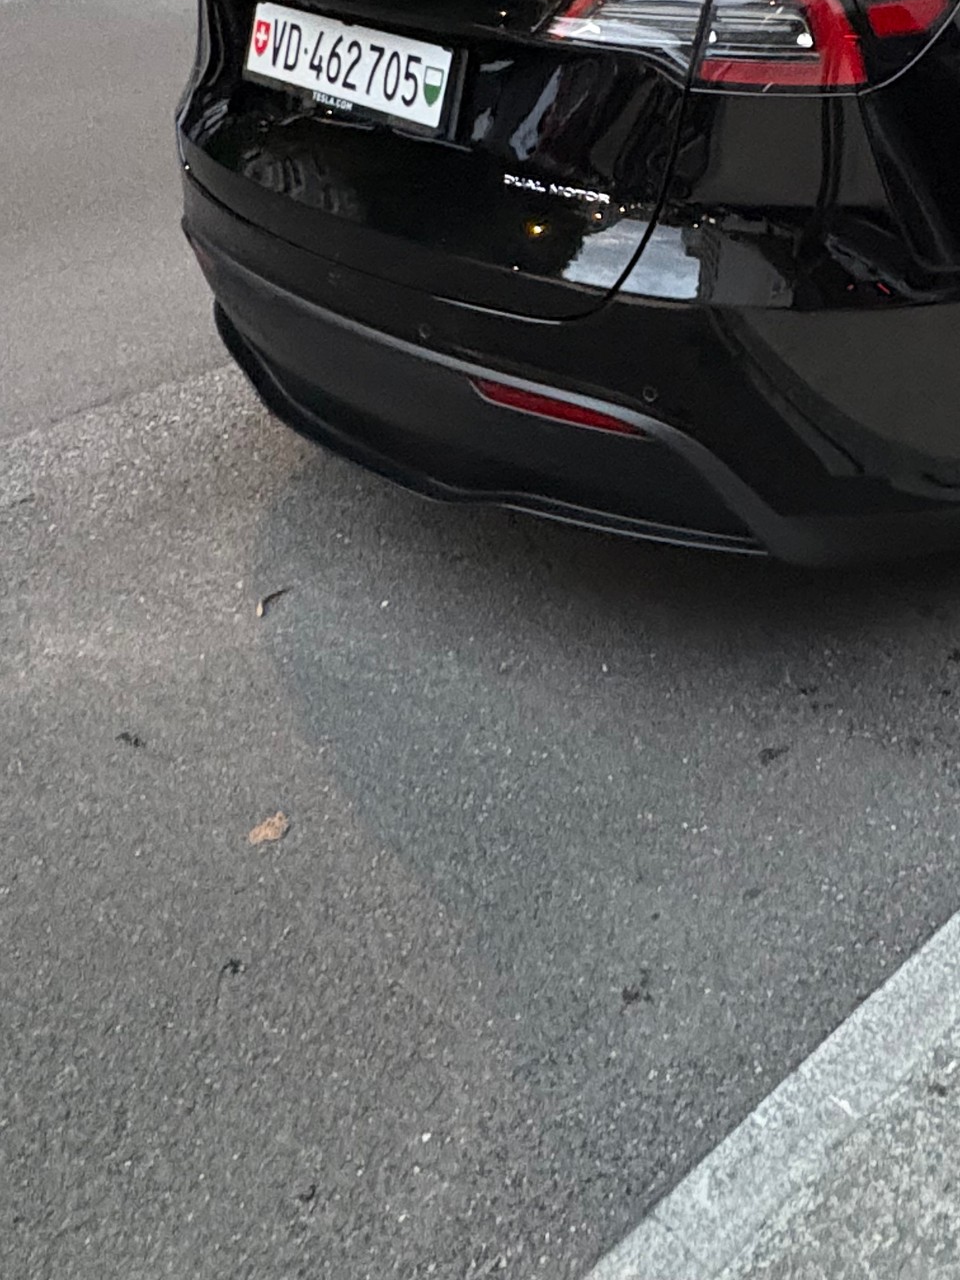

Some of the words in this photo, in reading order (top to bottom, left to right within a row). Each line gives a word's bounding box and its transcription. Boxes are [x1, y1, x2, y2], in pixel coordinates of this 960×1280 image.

[312, 91, 353, 111] TESLA.COM
[503, 173, 547, 193] DUAL
[549, 182, 611, 205] MOTOR
